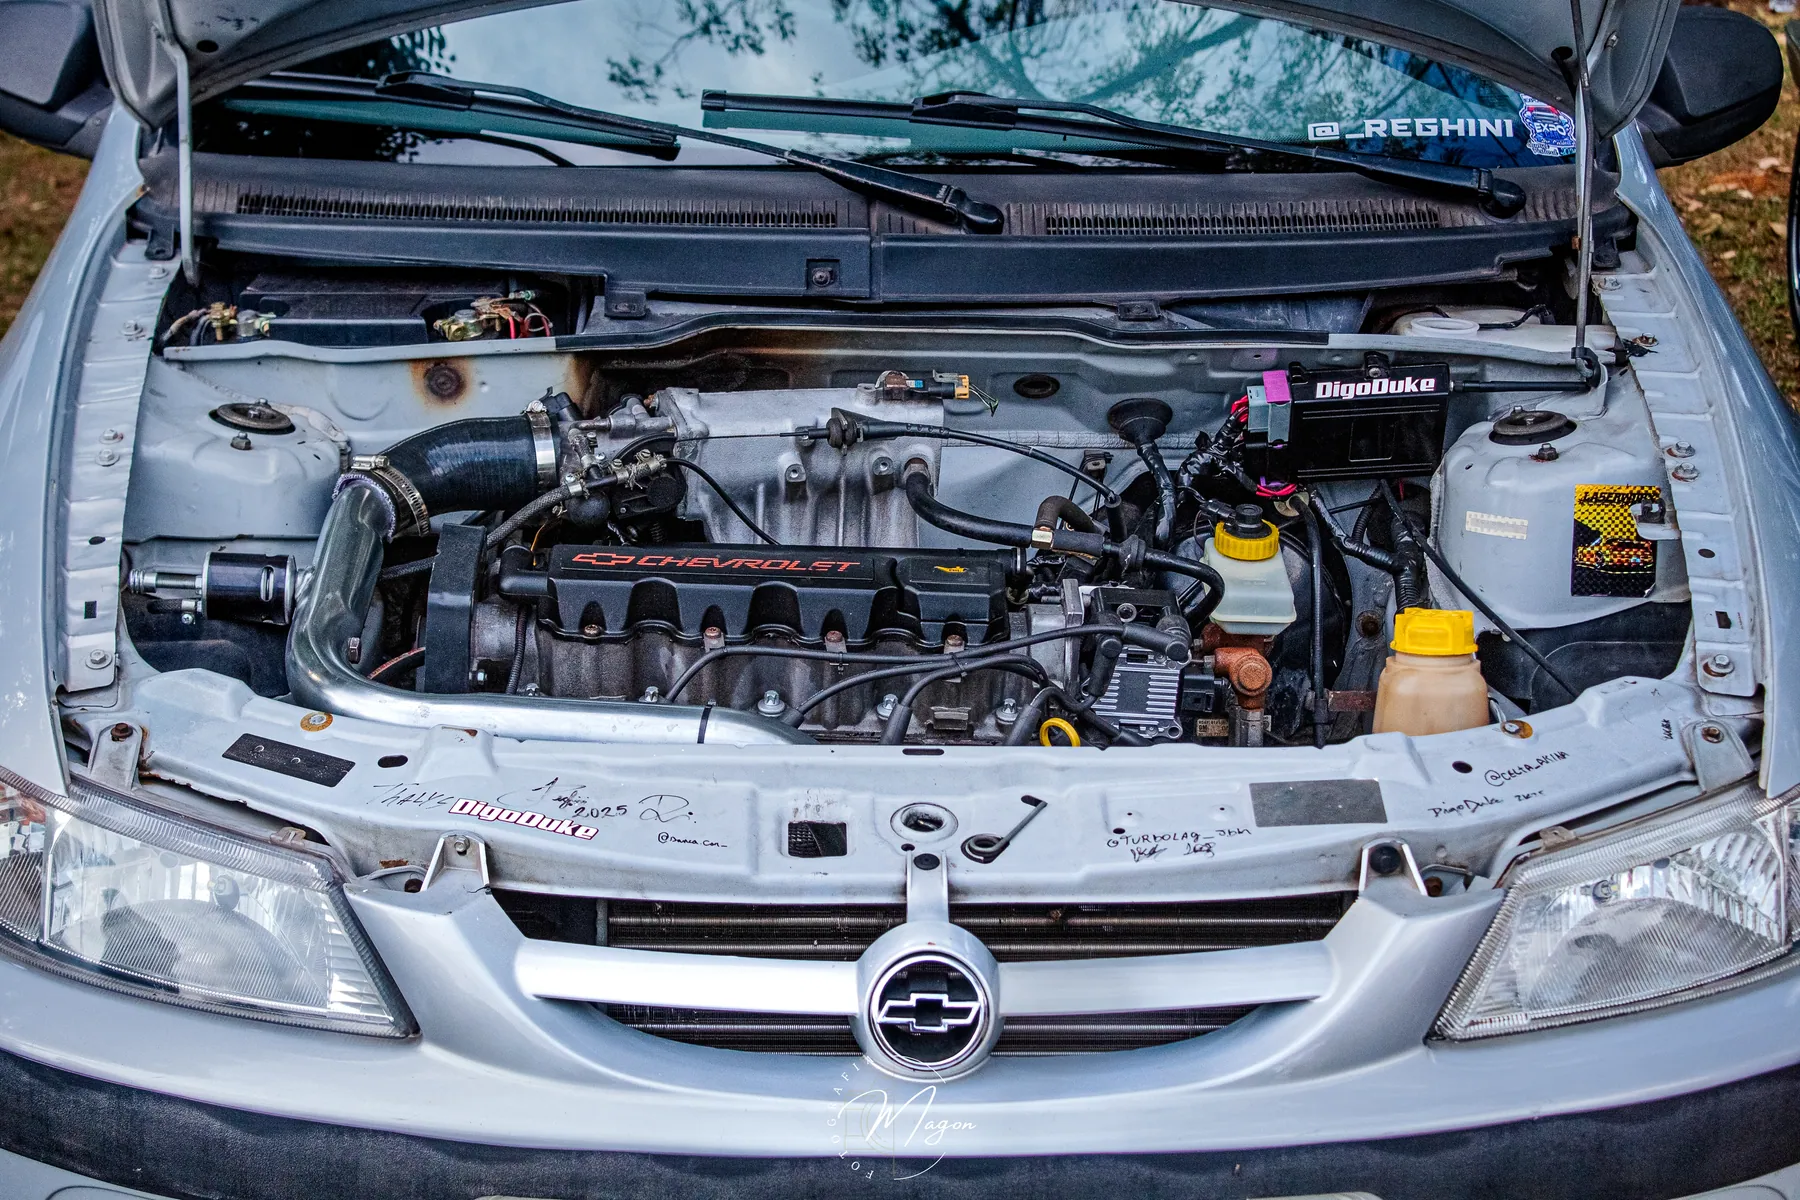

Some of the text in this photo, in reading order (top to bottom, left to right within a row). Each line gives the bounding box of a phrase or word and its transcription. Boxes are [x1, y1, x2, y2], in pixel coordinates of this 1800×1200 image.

[1533, 122, 1567, 136] EXPO
[1315, 376, 1437, 400] DigoDuke
[637, 554, 861, 573] CHEVROLET
[448, 797, 600, 841] DigoDuke
[572, 804, 628, 819] 2025
